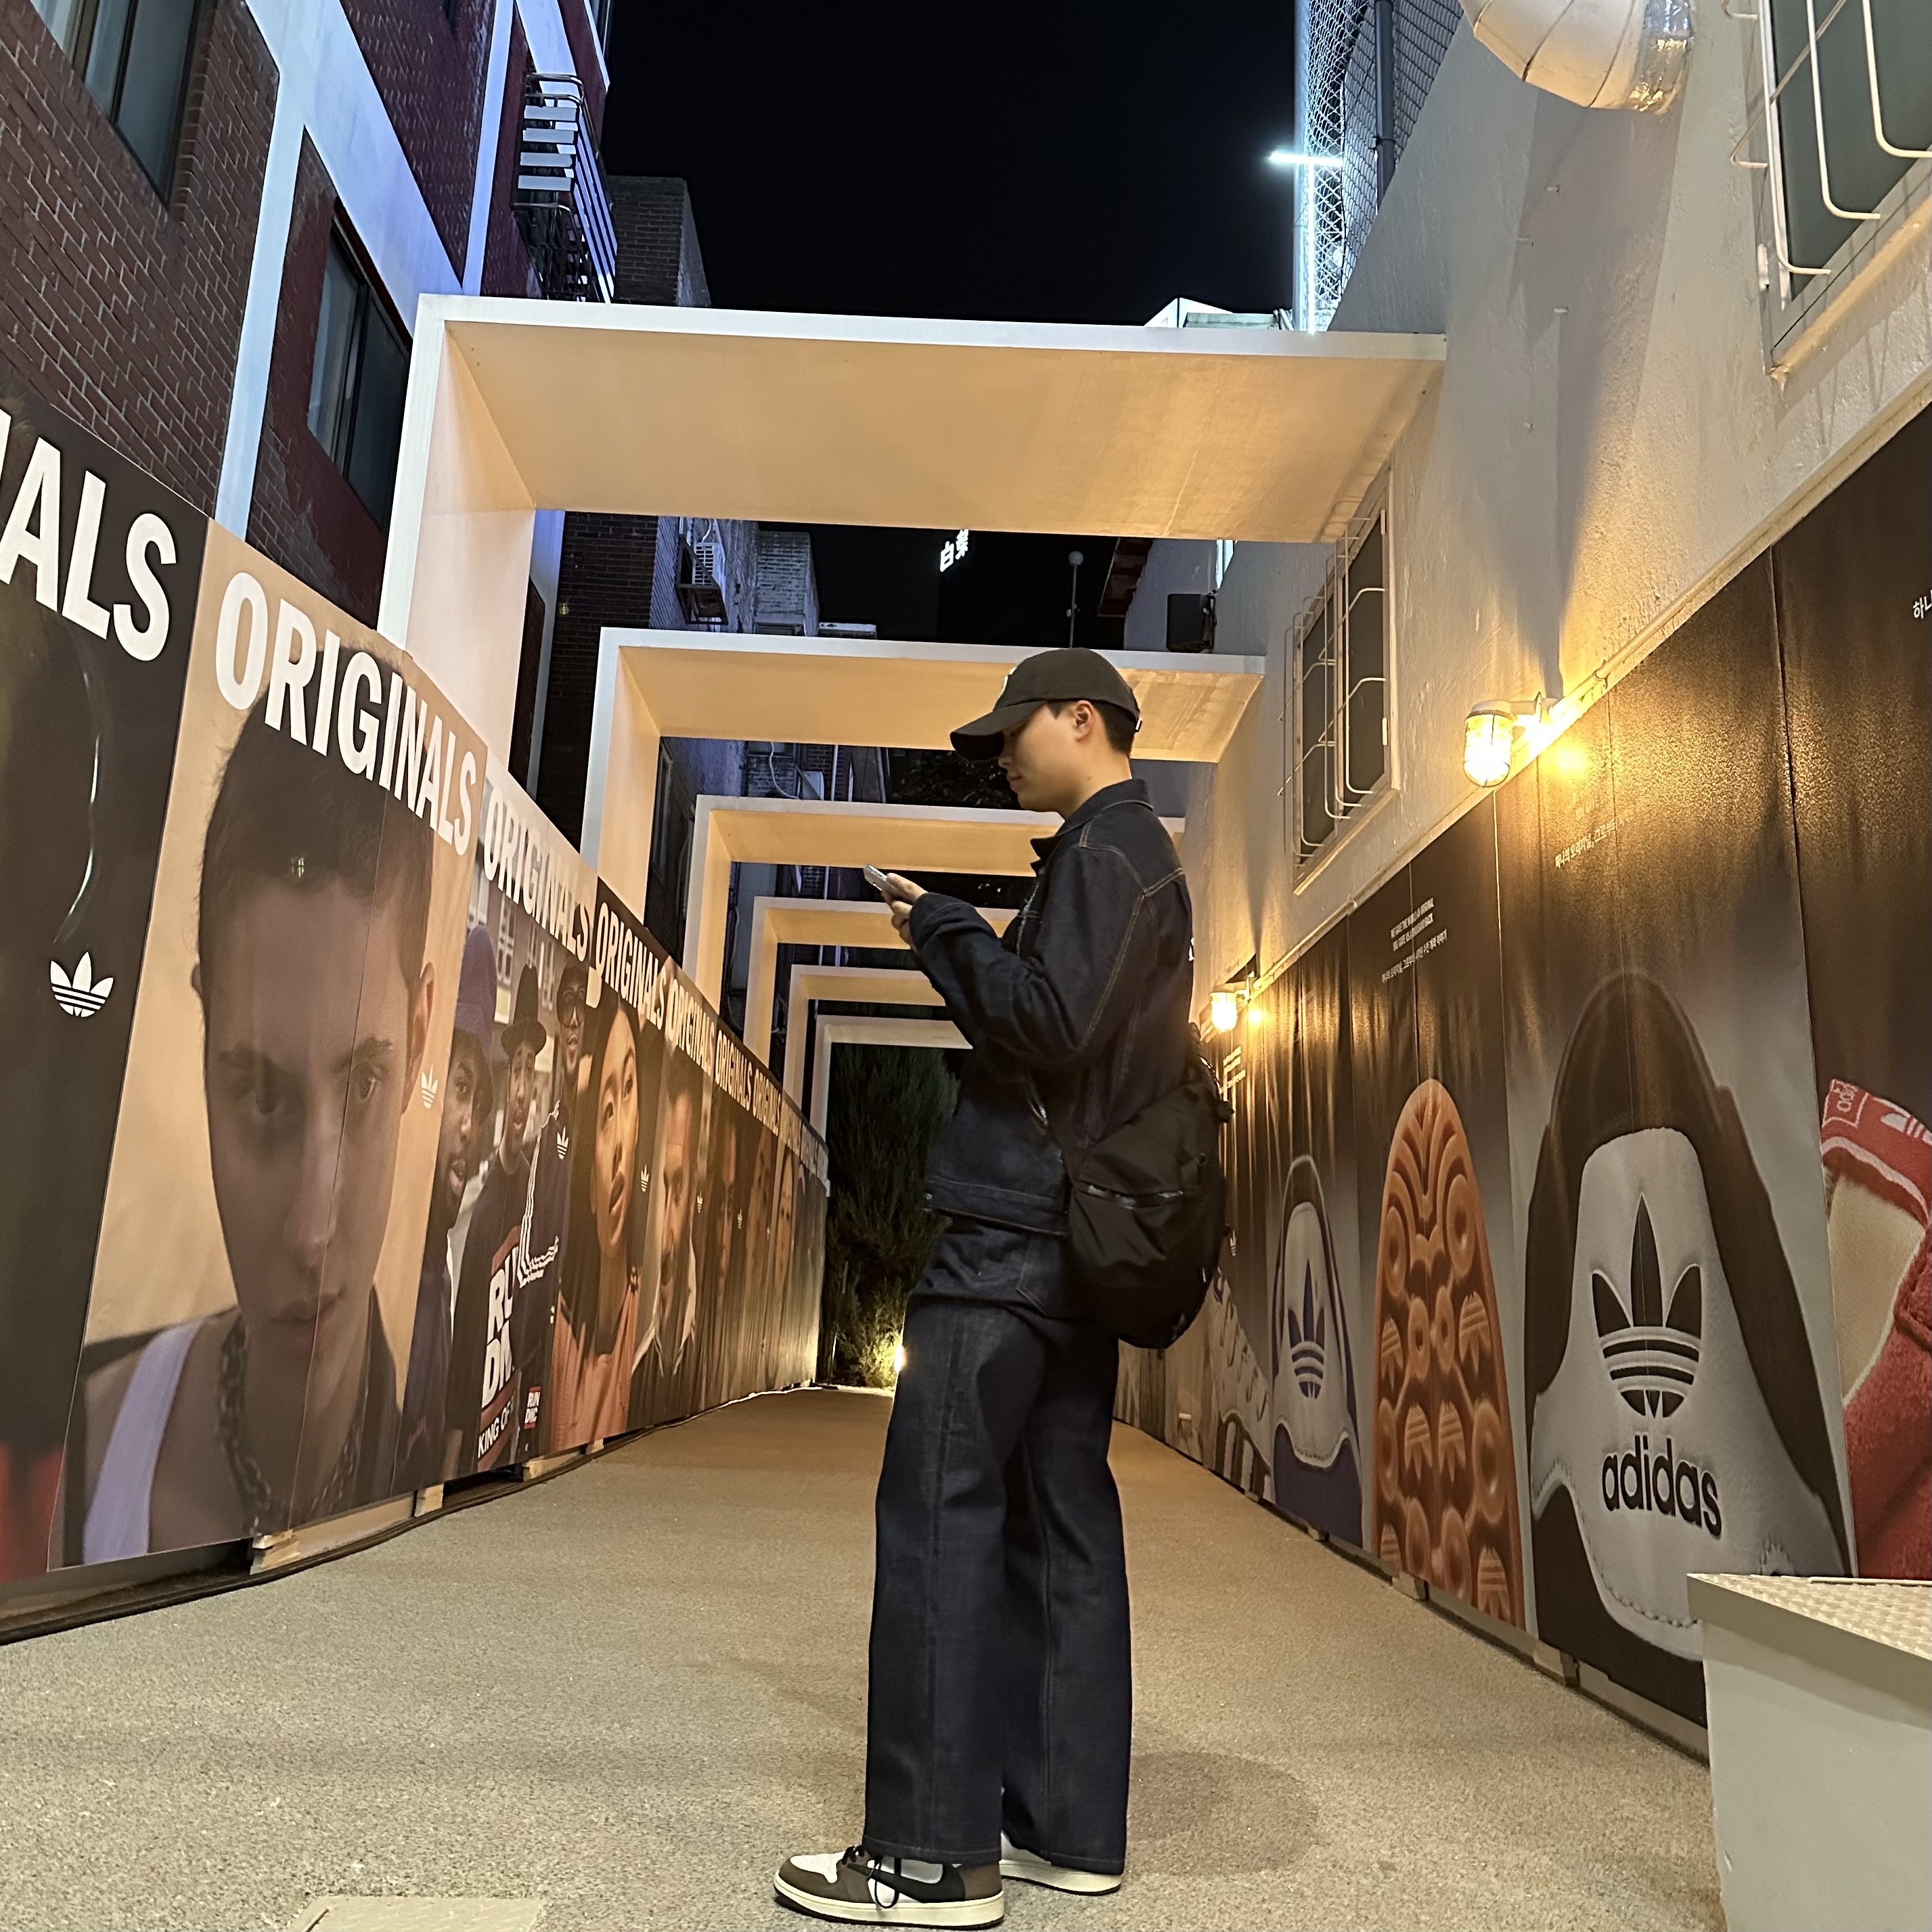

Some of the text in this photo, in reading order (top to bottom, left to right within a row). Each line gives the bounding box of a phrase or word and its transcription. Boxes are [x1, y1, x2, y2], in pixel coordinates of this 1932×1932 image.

[0, 408, 176, 661] ALS
[216, 572, 476, 855] ORIGINALS
[484, 786, 589, 962] ORIGINALS
[596, 902, 667, 1031] ORIGINALS
[665, 979, 715, 1077] ORIGINALS
[715, 1030, 752, 1111] ORIGINALS
[487, 1246, 519, 1345] RU
[481, 1320, 515, 1409] DM
[478, 1417, 499, 1458] KING
[1601, 1433, 1722, 1540] adidas
